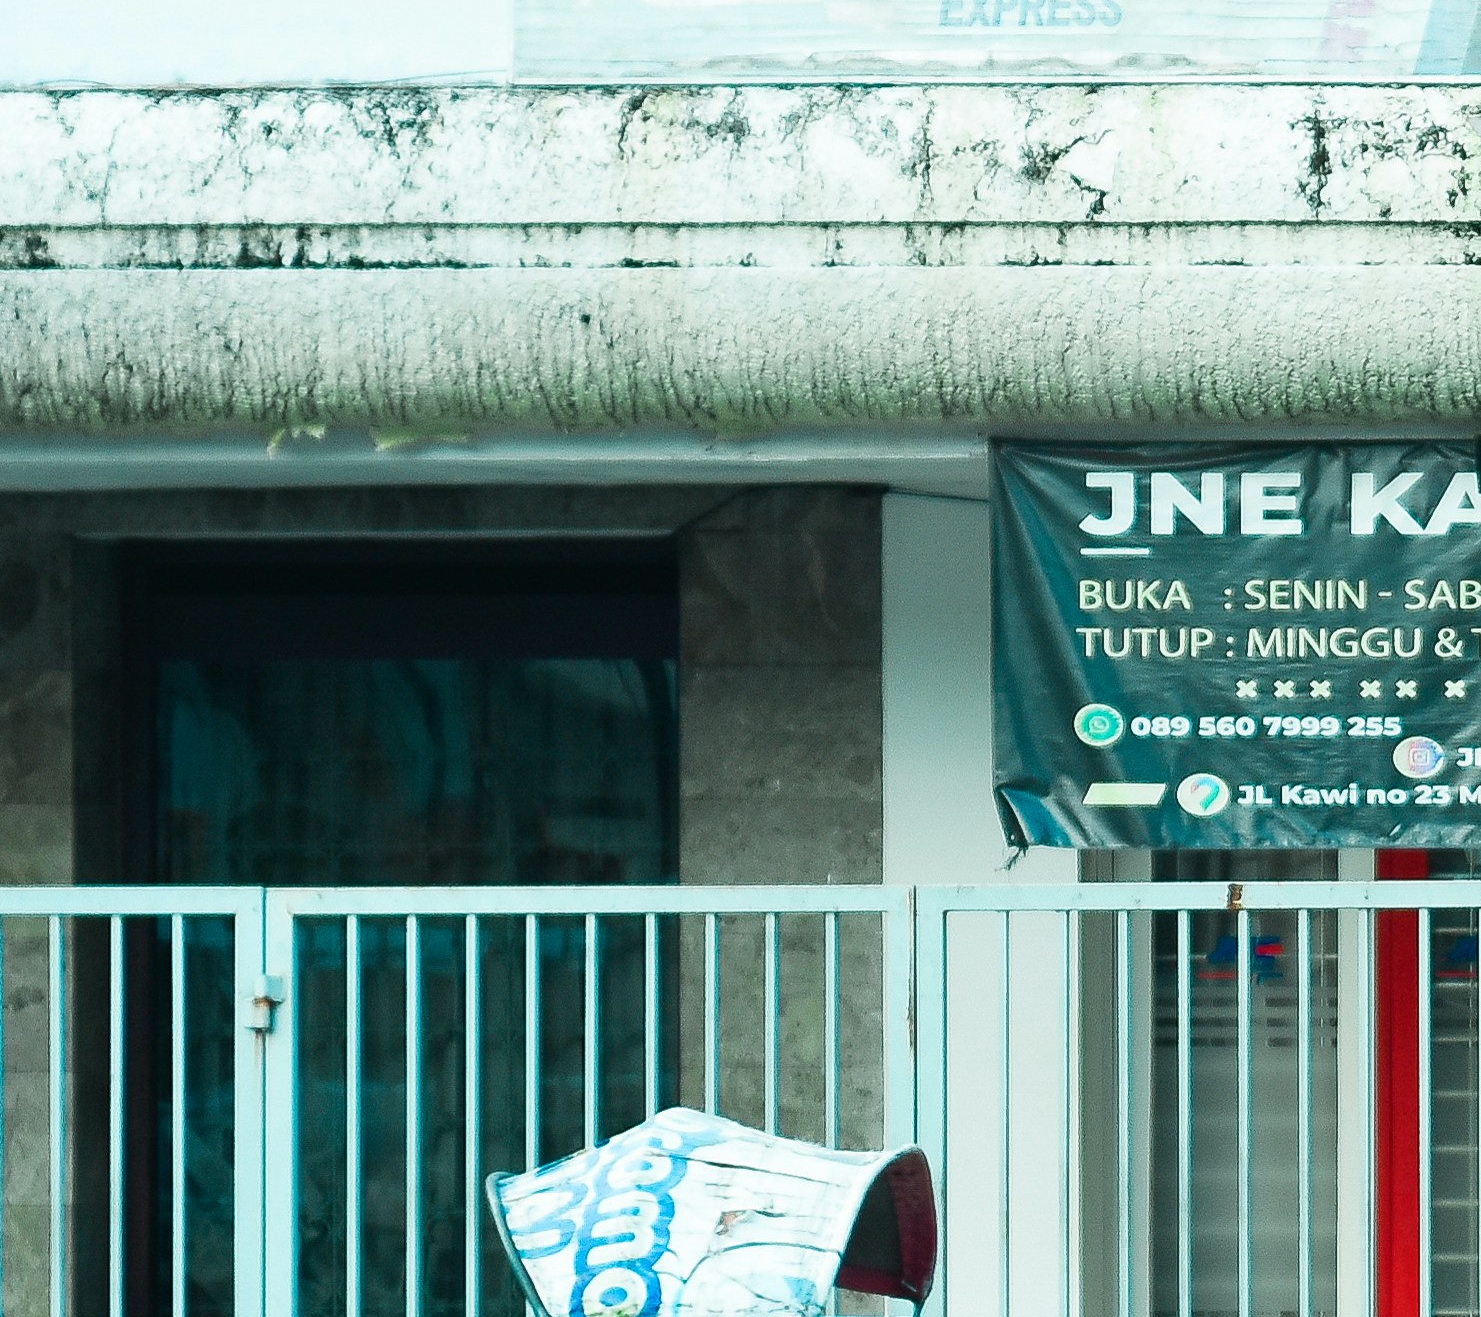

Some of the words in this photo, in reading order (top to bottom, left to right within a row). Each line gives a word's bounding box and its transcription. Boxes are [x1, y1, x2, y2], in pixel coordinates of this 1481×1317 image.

[1079, 472, 1304, 536] JNE
[1079, 580, 1191, 610] BUKA
[1244, 580, 1366, 610] SENIN
[1075, 627, 1214, 657] TUTUP
[1247, 627, 1421, 658] MINGGU
[1434, 627, 1463, 658] &
[1130, 716, 1190, 736] 089
[1198, 716, 1255, 736] 560
[1262, 716, 1340, 736] 7999
[1347, 716, 1402, 736] 255
[1237, 785, 1273, 805] JL
[1281, 783, 1357, 805] Kawi
[1366, 790, 1406, 805] no
[1414, 784, 1450, 805] 23
